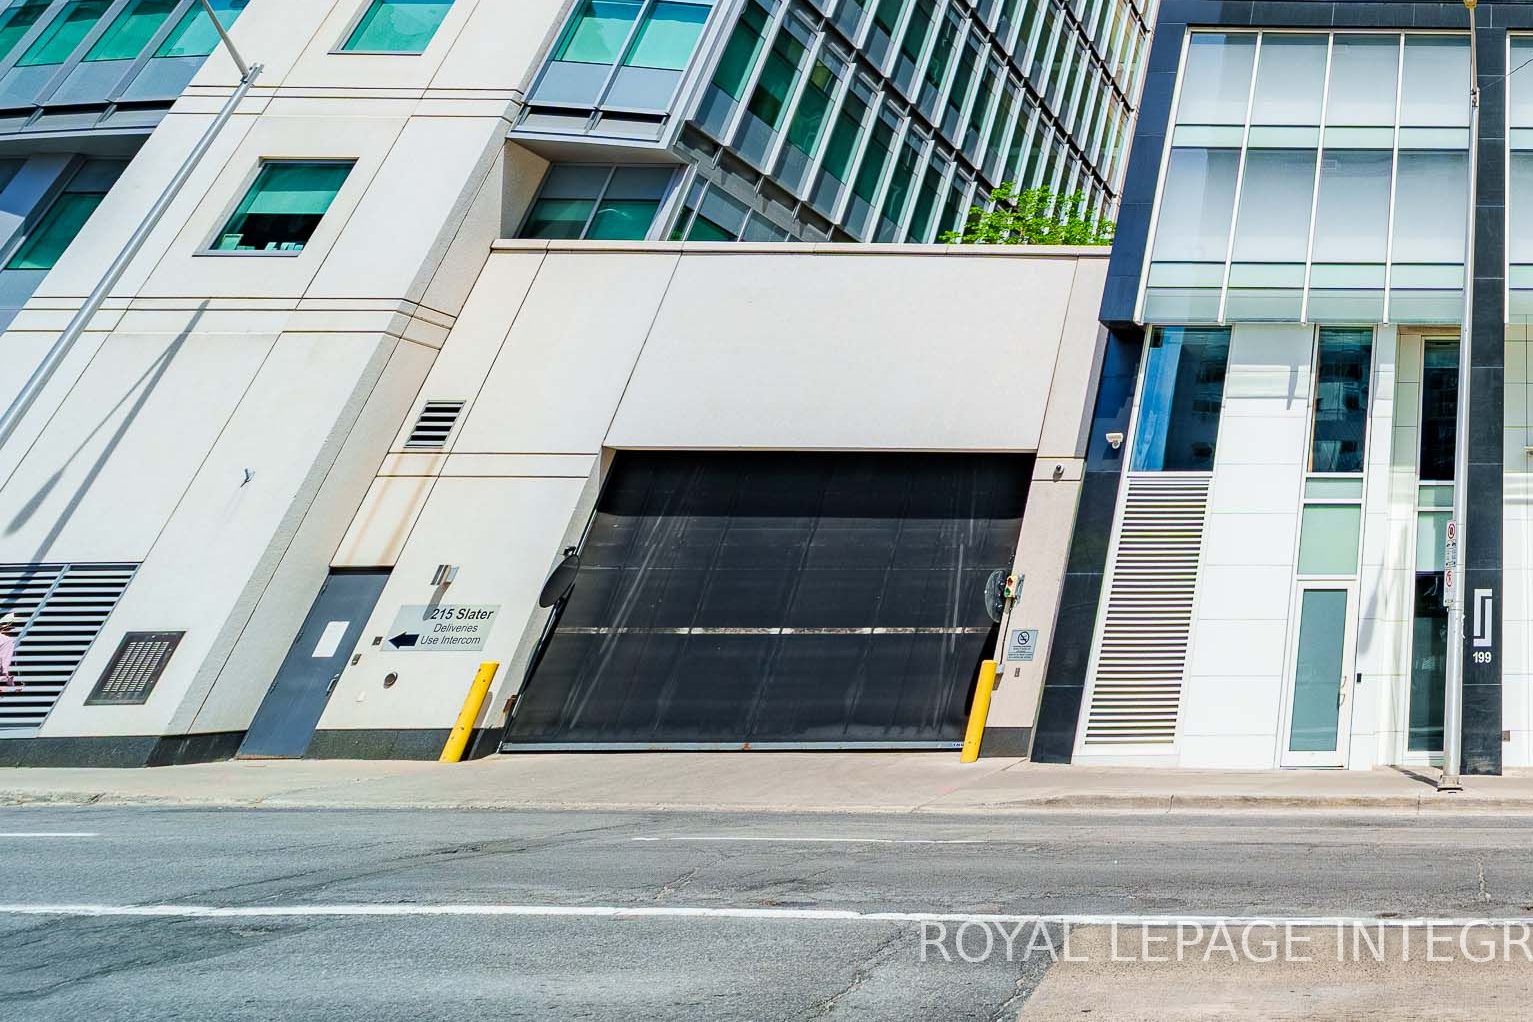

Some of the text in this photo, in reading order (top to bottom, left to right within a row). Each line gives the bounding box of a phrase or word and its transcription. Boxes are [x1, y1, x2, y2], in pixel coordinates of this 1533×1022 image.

[430, 608, 494, 620] 215 Slater
[433, 623, 478, 633] Deliveries
[420, 635, 481, 645] Use Intercom
[1472, 651, 1492, 663] 199
